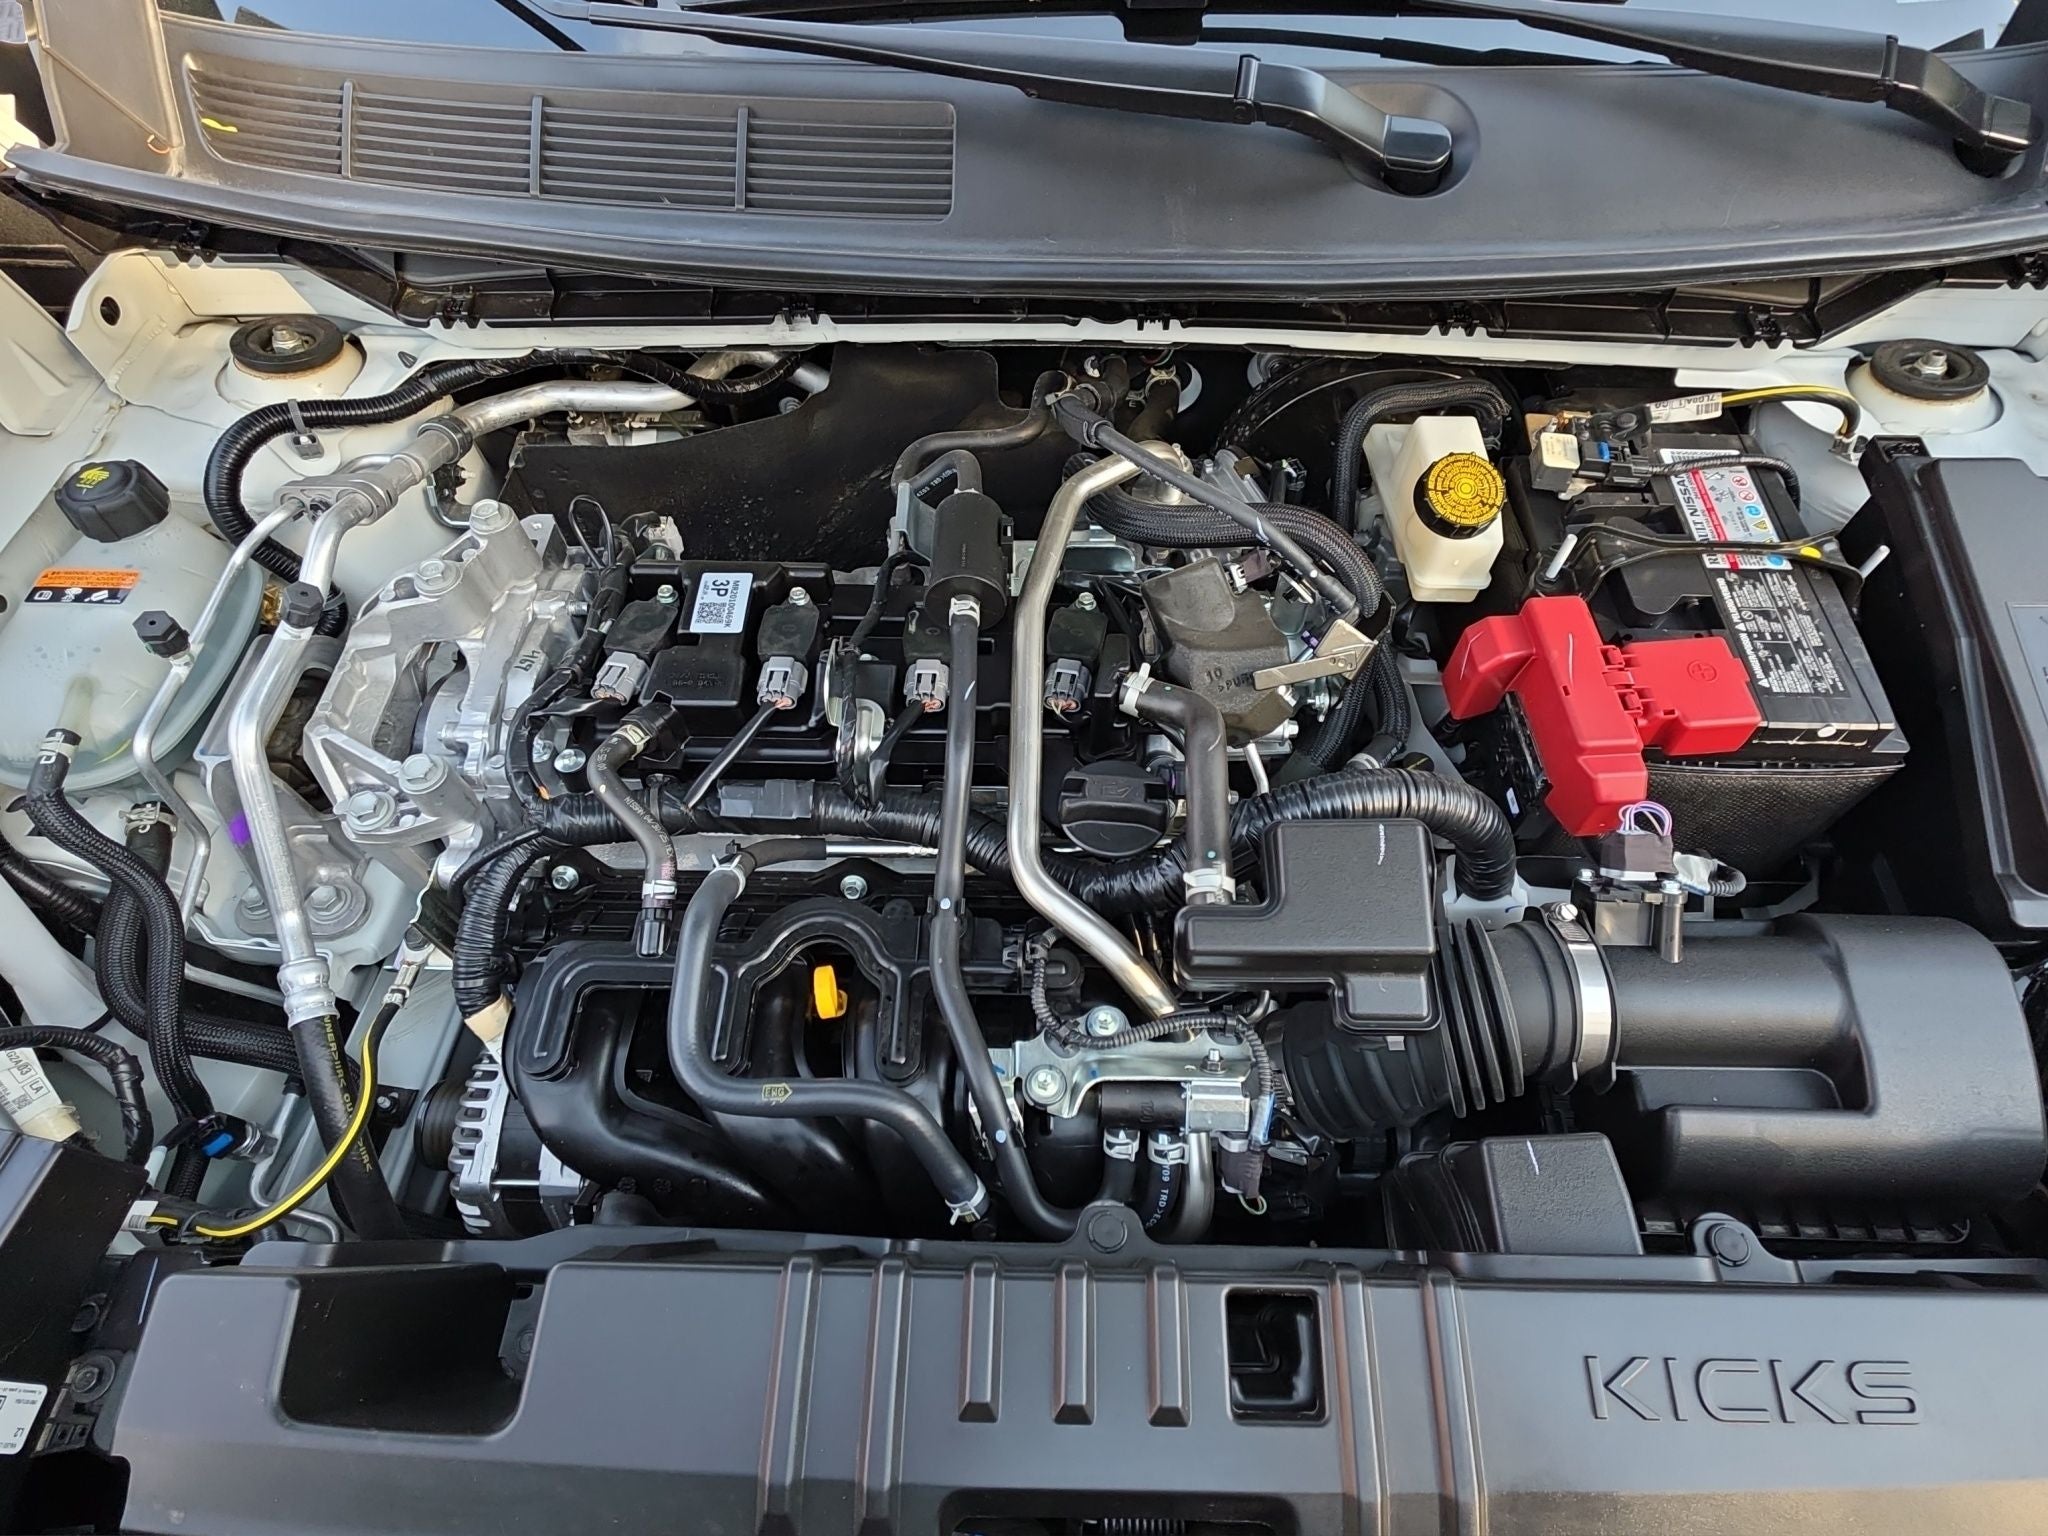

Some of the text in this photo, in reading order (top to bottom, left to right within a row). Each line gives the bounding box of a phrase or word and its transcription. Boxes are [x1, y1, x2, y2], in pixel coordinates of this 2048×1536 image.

[711, 579, 730, 597] 3P
[765, 1086, 785, 1098] ENG
[1584, 1355, 1920, 1425] KICKS
